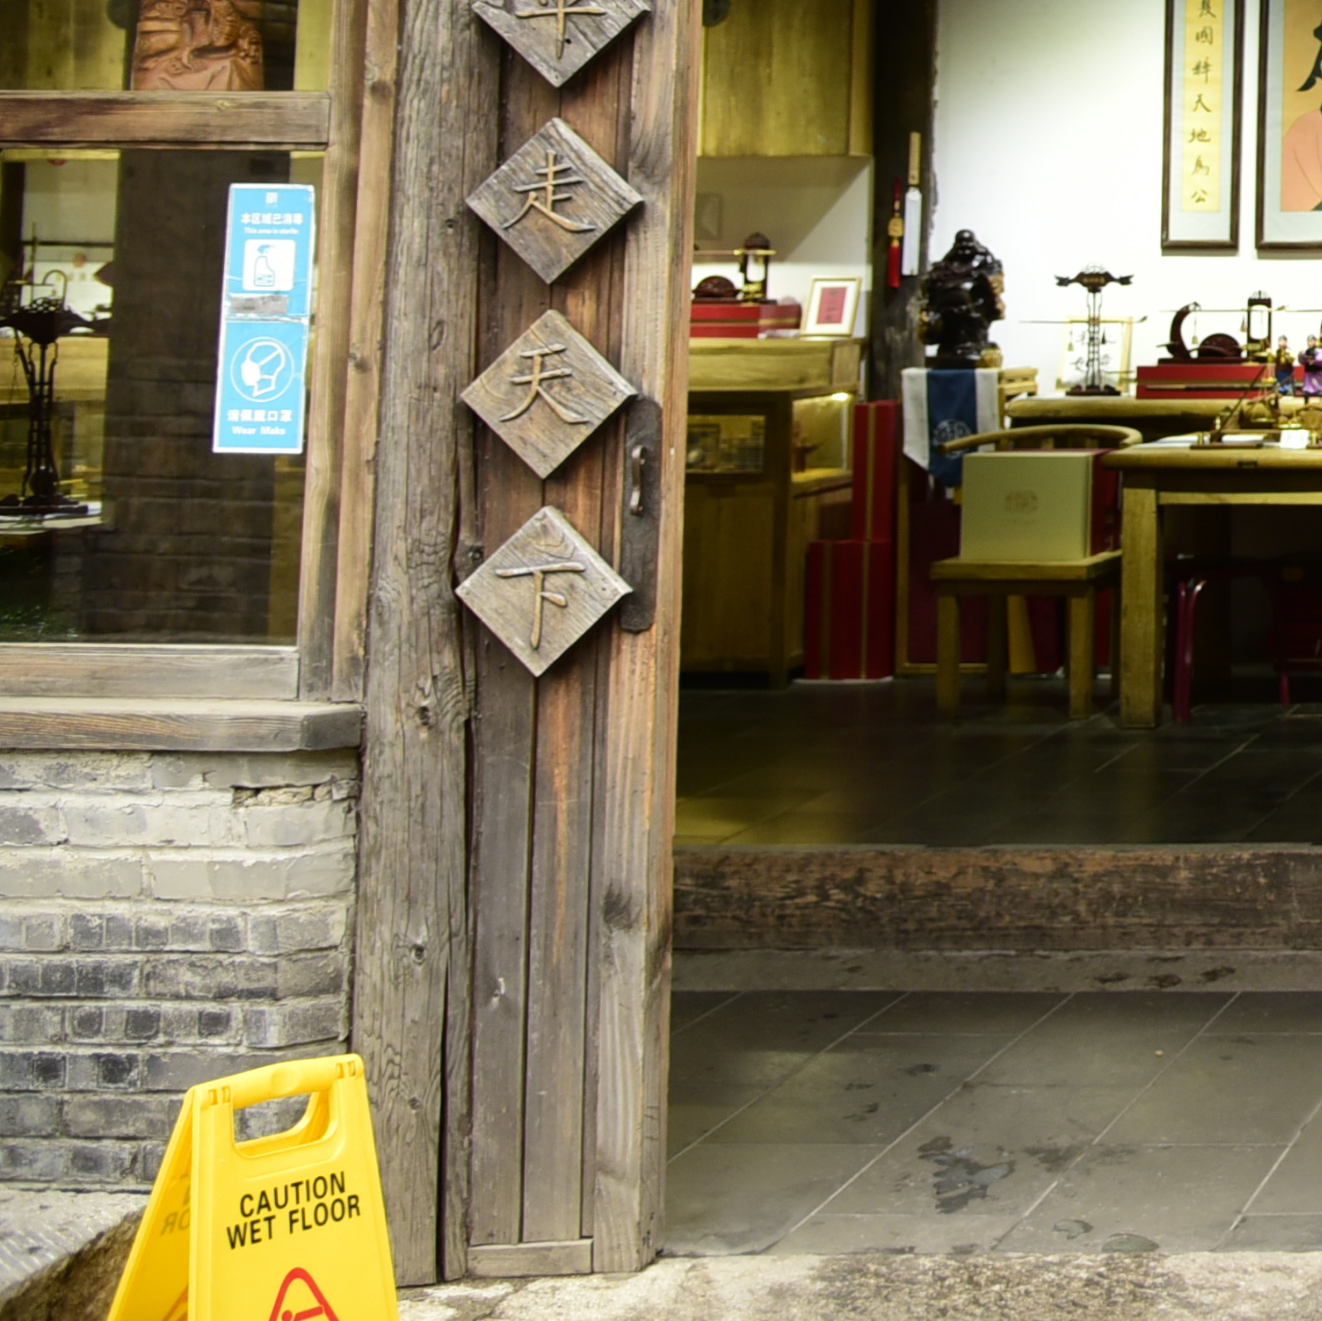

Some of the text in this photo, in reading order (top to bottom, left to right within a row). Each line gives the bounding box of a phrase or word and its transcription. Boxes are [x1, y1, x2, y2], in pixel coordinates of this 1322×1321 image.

[232, 426, 257, 435] Wear
[240, 1171, 346, 1218] CAUTION
[226, 1215, 277, 1251] WET
[288, 1194, 361, 1234] FLOOR
